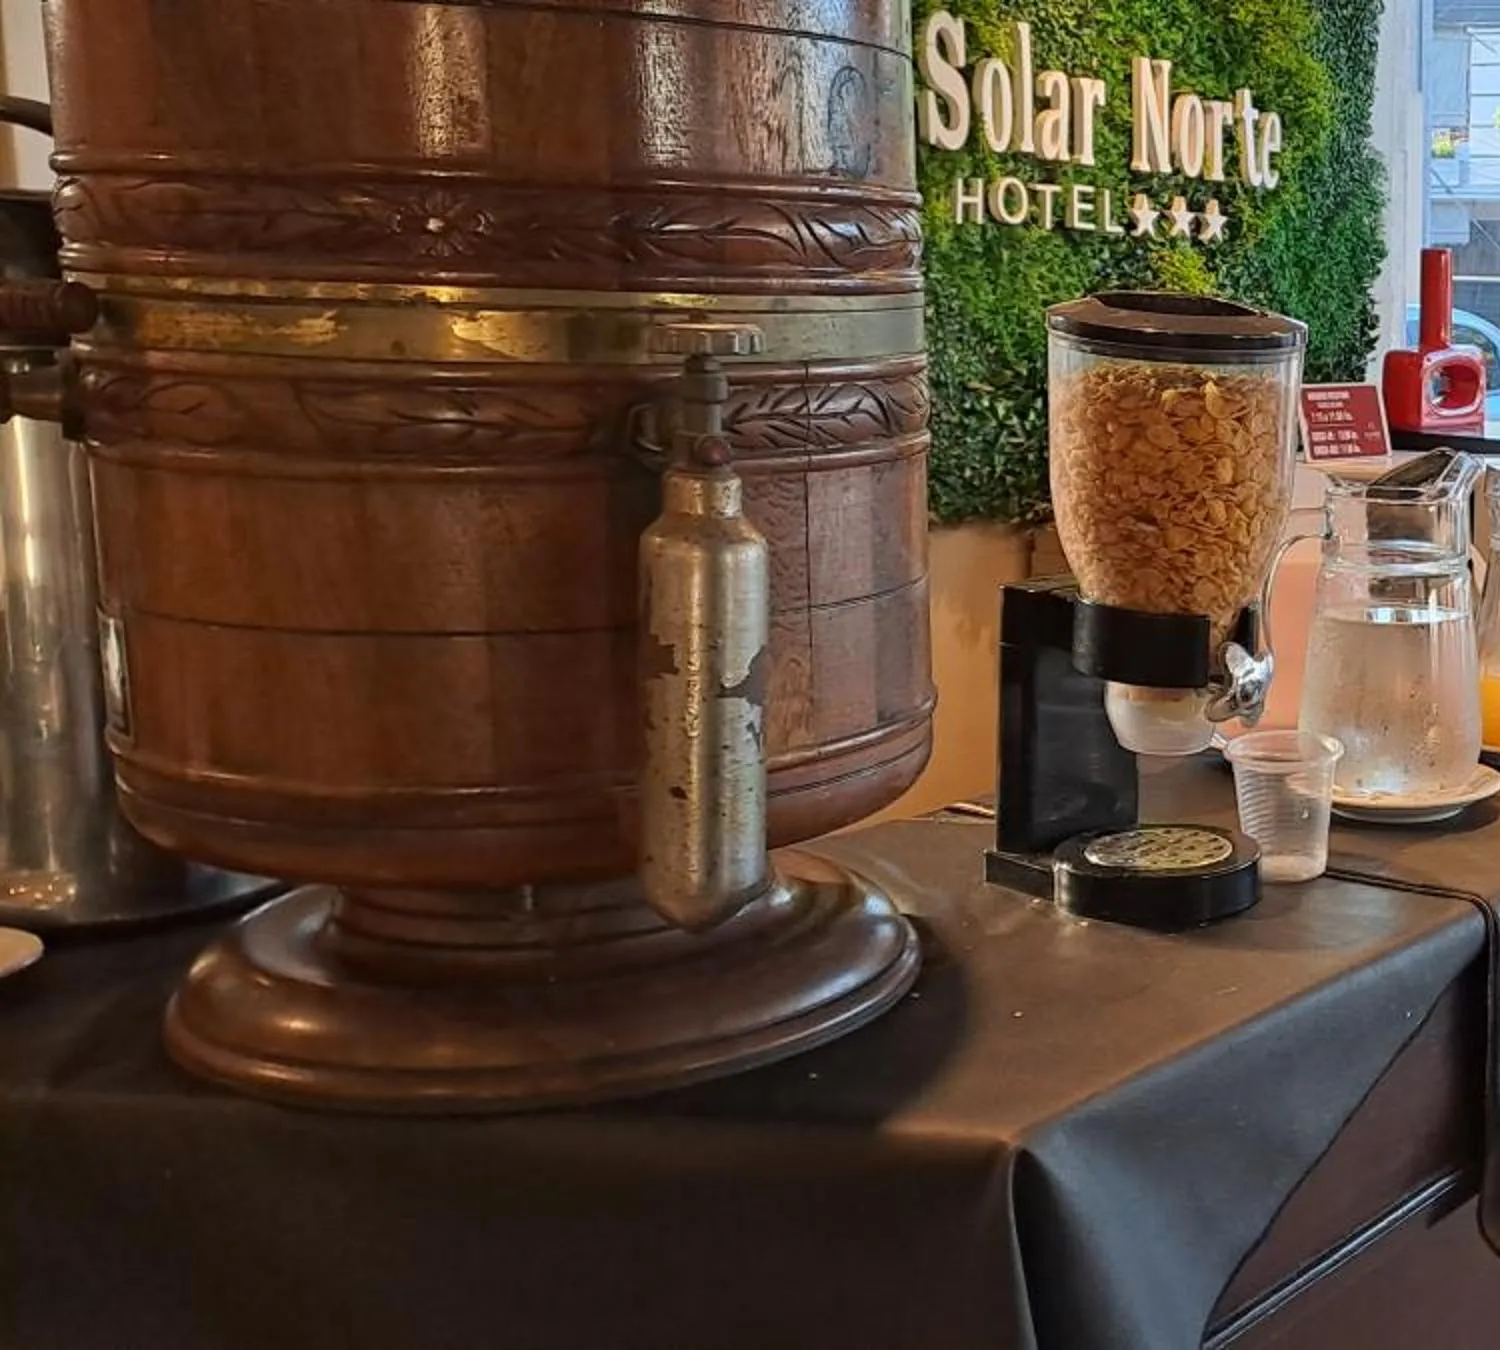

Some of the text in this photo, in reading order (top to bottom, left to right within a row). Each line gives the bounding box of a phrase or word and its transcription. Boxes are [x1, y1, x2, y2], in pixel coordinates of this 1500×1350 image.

[917, 9, 1282, 190] Solar Norte
[953, 176, 1126, 235] HOTEL
